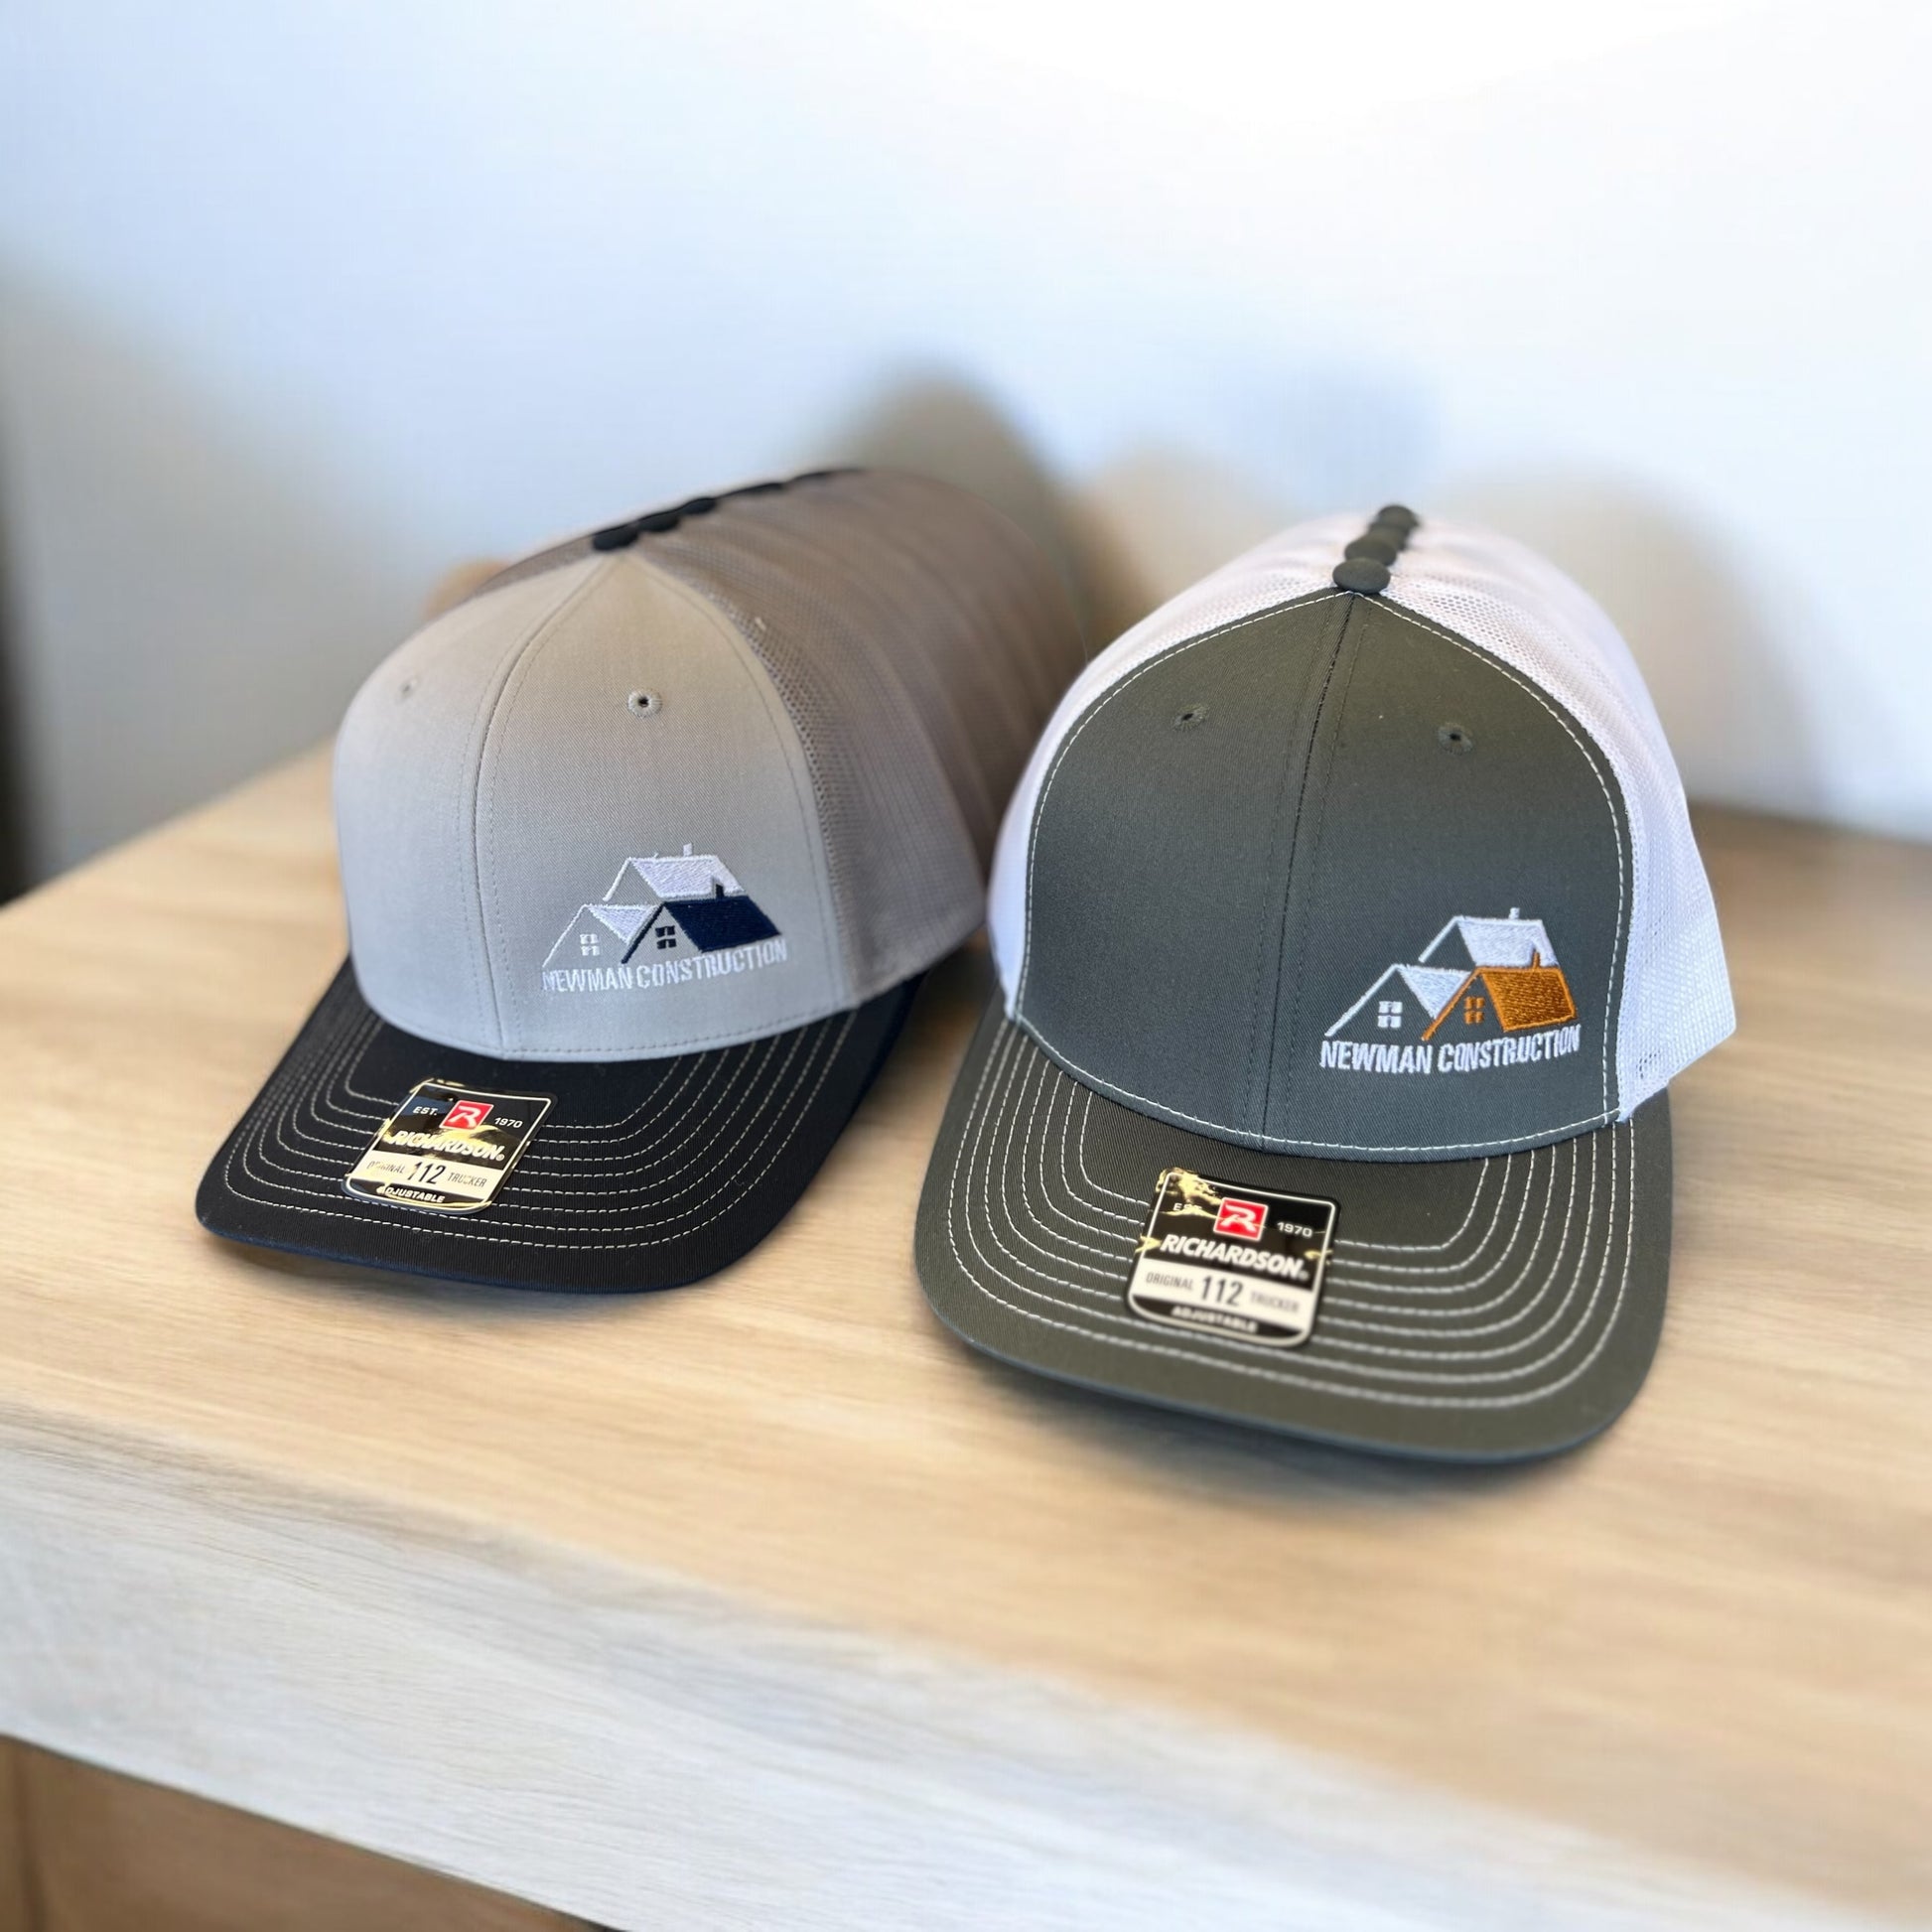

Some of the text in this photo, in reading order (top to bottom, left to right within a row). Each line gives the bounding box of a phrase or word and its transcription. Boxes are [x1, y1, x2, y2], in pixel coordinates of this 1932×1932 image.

[542, 938, 788, 993] NEWMAN CONSTRUCTION
[1319, 1024, 1582, 1074] NEWMAN CONSTRUCTION
[412, 1106, 438, 1116] EST.
[493, 1117, 523, 1129] 1970
[407, 1161, 447, 1184] 112
[1277, 1221, 1312, 1238] 1970
[1160, 1234, 1305, 1279] RICHARDSON
[1146, 1271, 1194, 1290] ORIGINAL
[1201, 1275, 1244, 1307] 112
[1171, 1306, 1258, 1333] ADJUSTABLE
